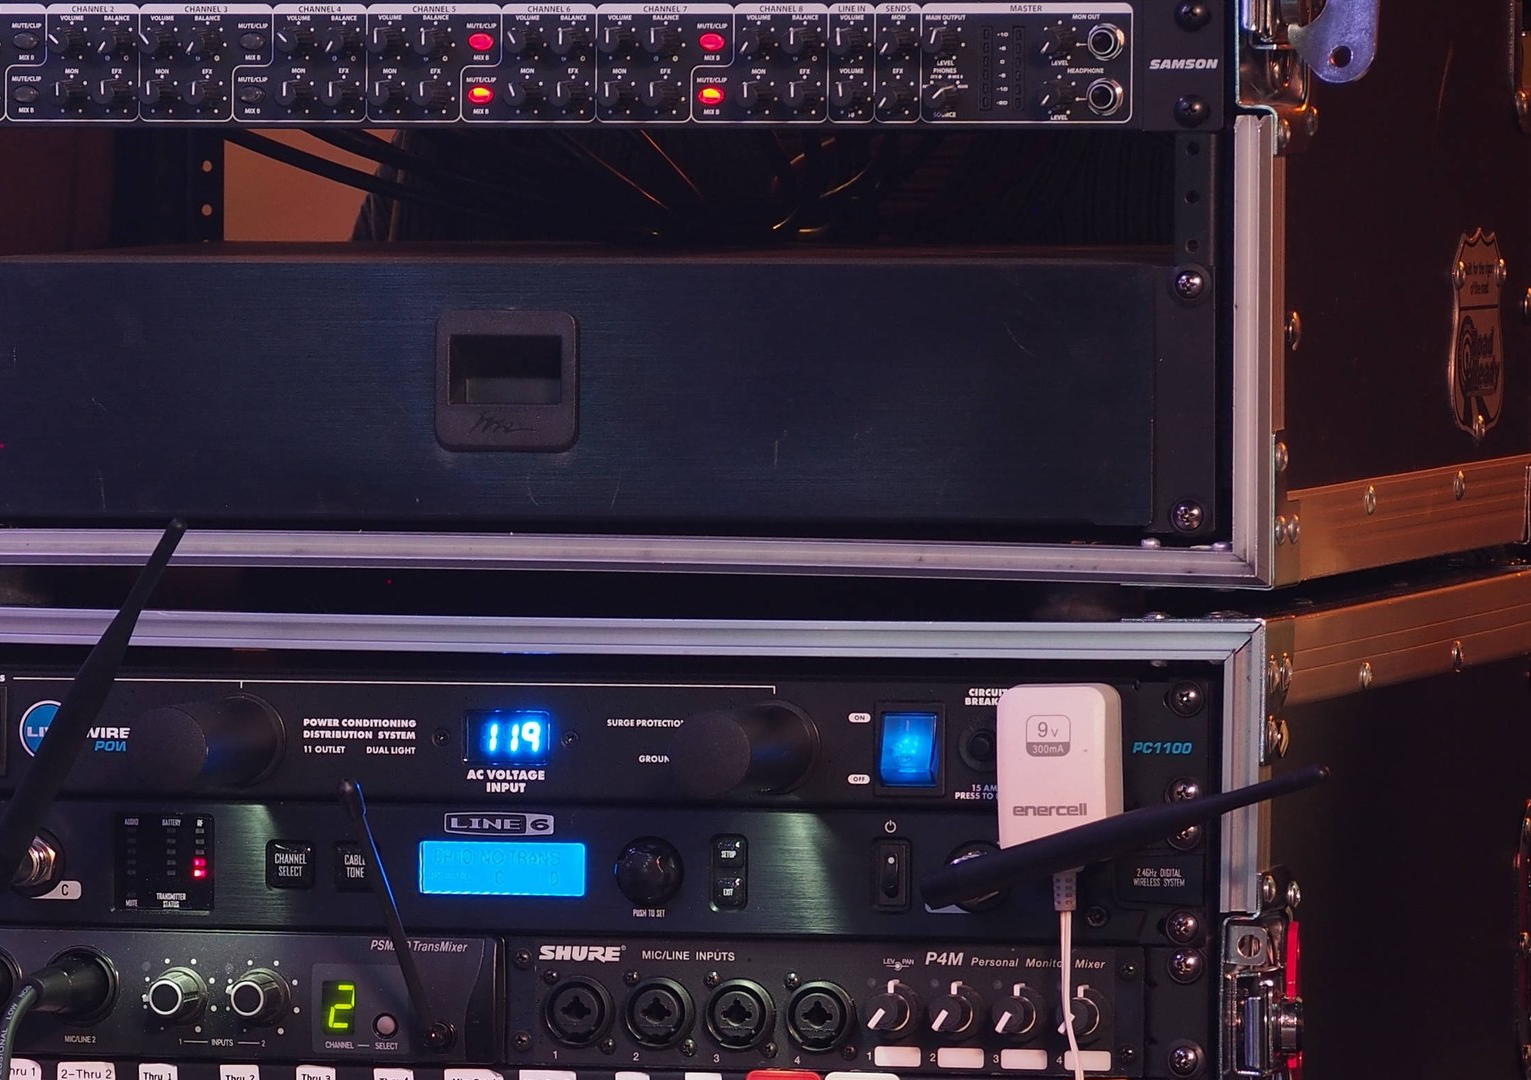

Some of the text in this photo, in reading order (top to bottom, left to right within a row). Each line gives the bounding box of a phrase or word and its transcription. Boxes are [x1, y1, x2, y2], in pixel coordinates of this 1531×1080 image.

[1149, 59, 1218, 69] SAMSON
[303, 719, 417, 728] POWER CONDITIONING
[303, 731, 416, 740] DISTRIBUTION SYSTEM
[1037, 722, 1048, 738] 9
[486, 721, 541, 752] 119
[315, 746, 346, 754] OUTLET
[391, 747, 416, 755] LIGHT
[1032, 745, 1064, 754] 300mA
[1132, 742, 1192, 754] PC1100
[467, 770, 545, 781] AC VOLTAGE
[486, 782, 526, 793] INPUT
[1013, 803, 1087, 816] enercell
[450, 817, 550, 831] LINE 6
[274, 853, 307, 865] CHANNEL
[278, 866, 302, 877] SELECT
[1137, 868, 1181, 877] 2.4GHz DIGITAL
[1133, 878, 1185, 887] WIRELESS SYSTEM
[413, 940, 467, 952] TransMixer
[539, 945, 621, 963] SHURE
[642, 950, 735, 961] MIC/LINE INPUTS
[925, 952, 1105, 968] P4M Personal Mixer
[328, 985, 355, 1028] 2
[325, 1041, 354, 1049] CHANNEL
[375, 1042, 398, 1050] SELECT
[61, 1069, 112, 1080] 2-Thru 2
[143, 1071, 172, 1080] Thru 1
